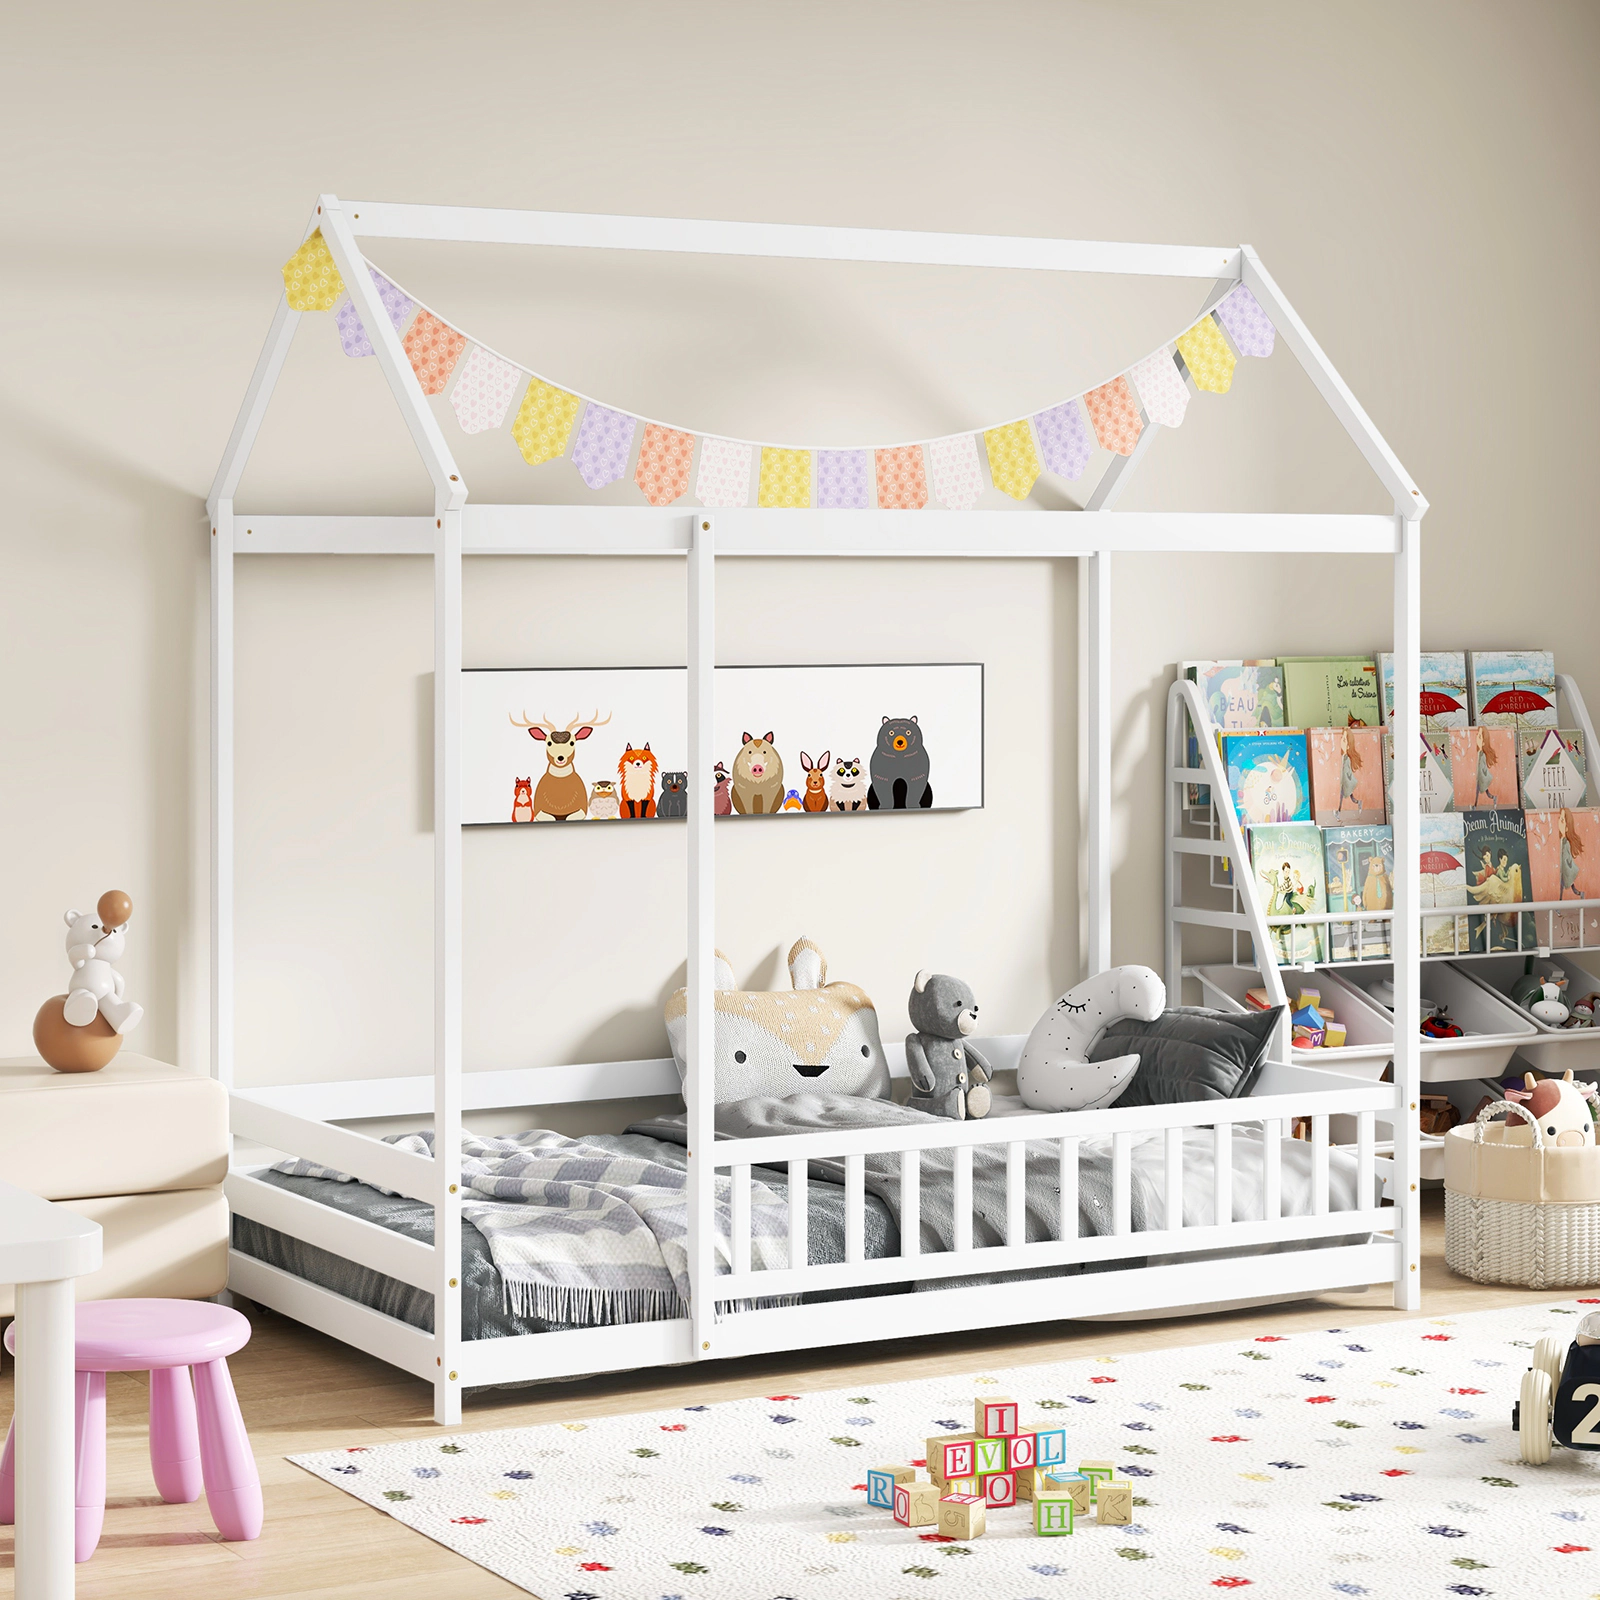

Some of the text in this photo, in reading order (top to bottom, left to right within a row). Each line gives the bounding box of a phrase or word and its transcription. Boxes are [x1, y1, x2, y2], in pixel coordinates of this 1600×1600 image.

[1498, 702, 1537, 710] UMBRELLA
[1543, 766, 1567, 787] PETER
[1340, 828, 1374, 839] BAKERY
[1489, 809, 1526, 839] Animals
[1571, 1383, 1600, 1445] 2
[1045, 1506, 1067, 1529] H
